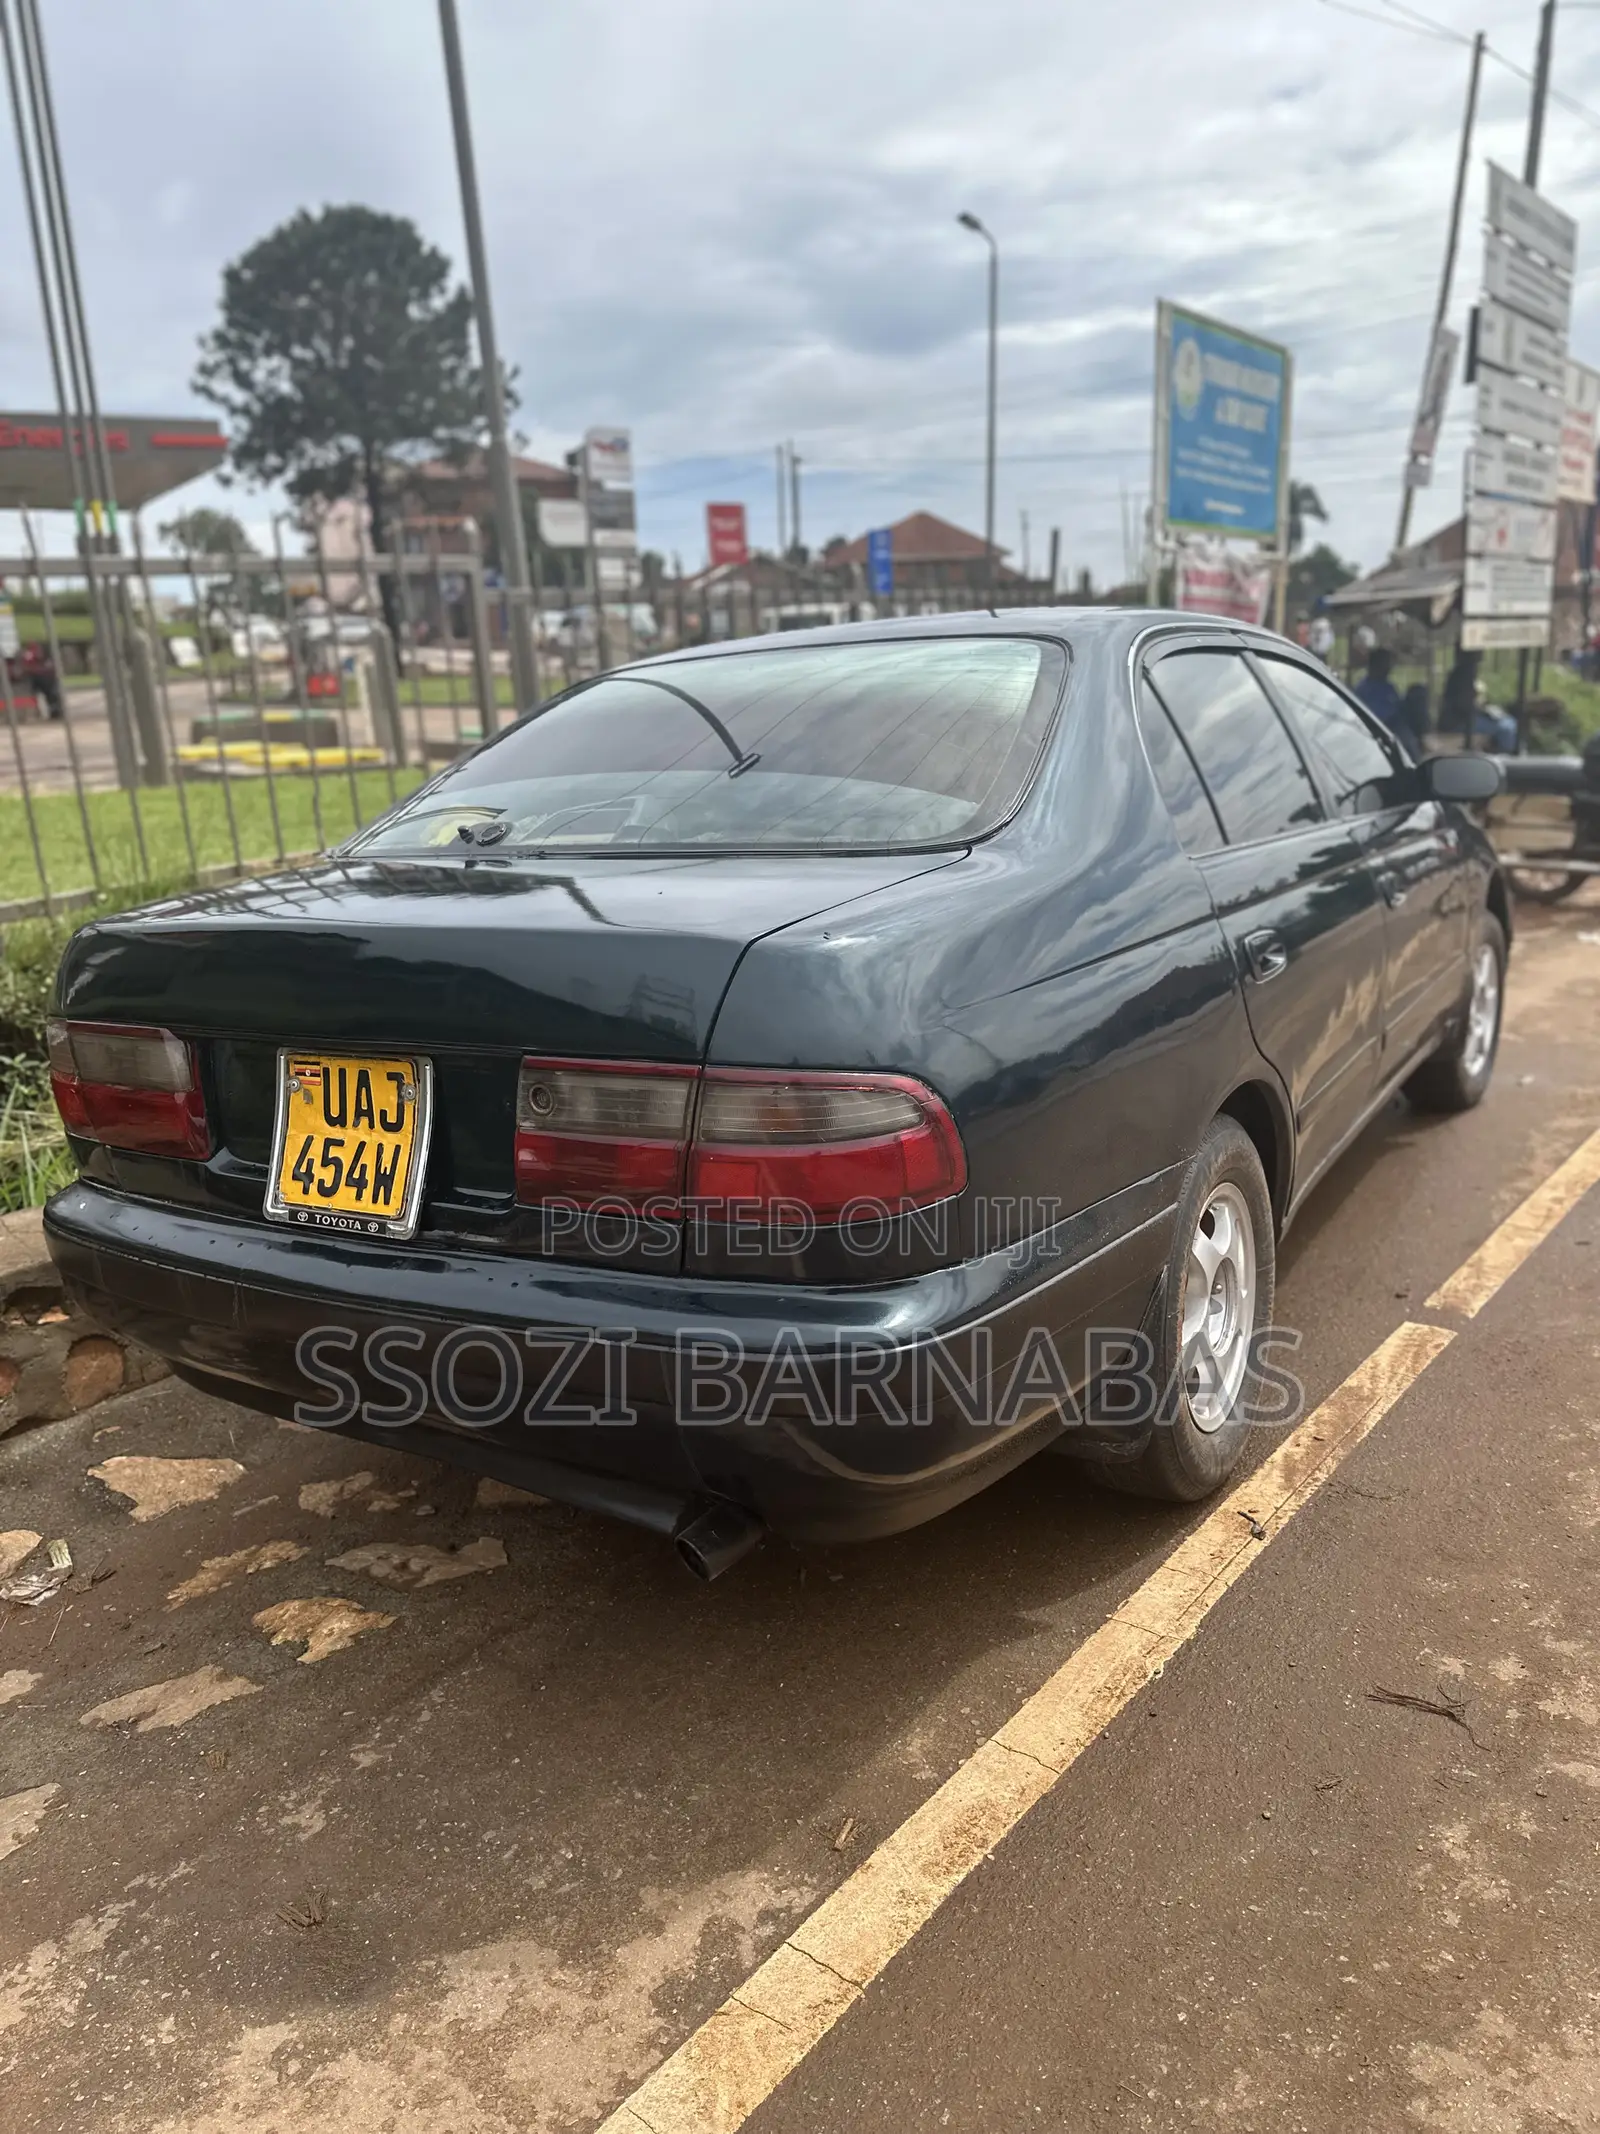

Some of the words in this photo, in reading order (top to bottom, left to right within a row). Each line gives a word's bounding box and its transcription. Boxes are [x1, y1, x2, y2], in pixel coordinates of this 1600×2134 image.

[322, 1067, 405, 1132] UAJ
[292, 1135, 401, 1206] 454W
[315, 1214, 362, 1231] TOYOTA
